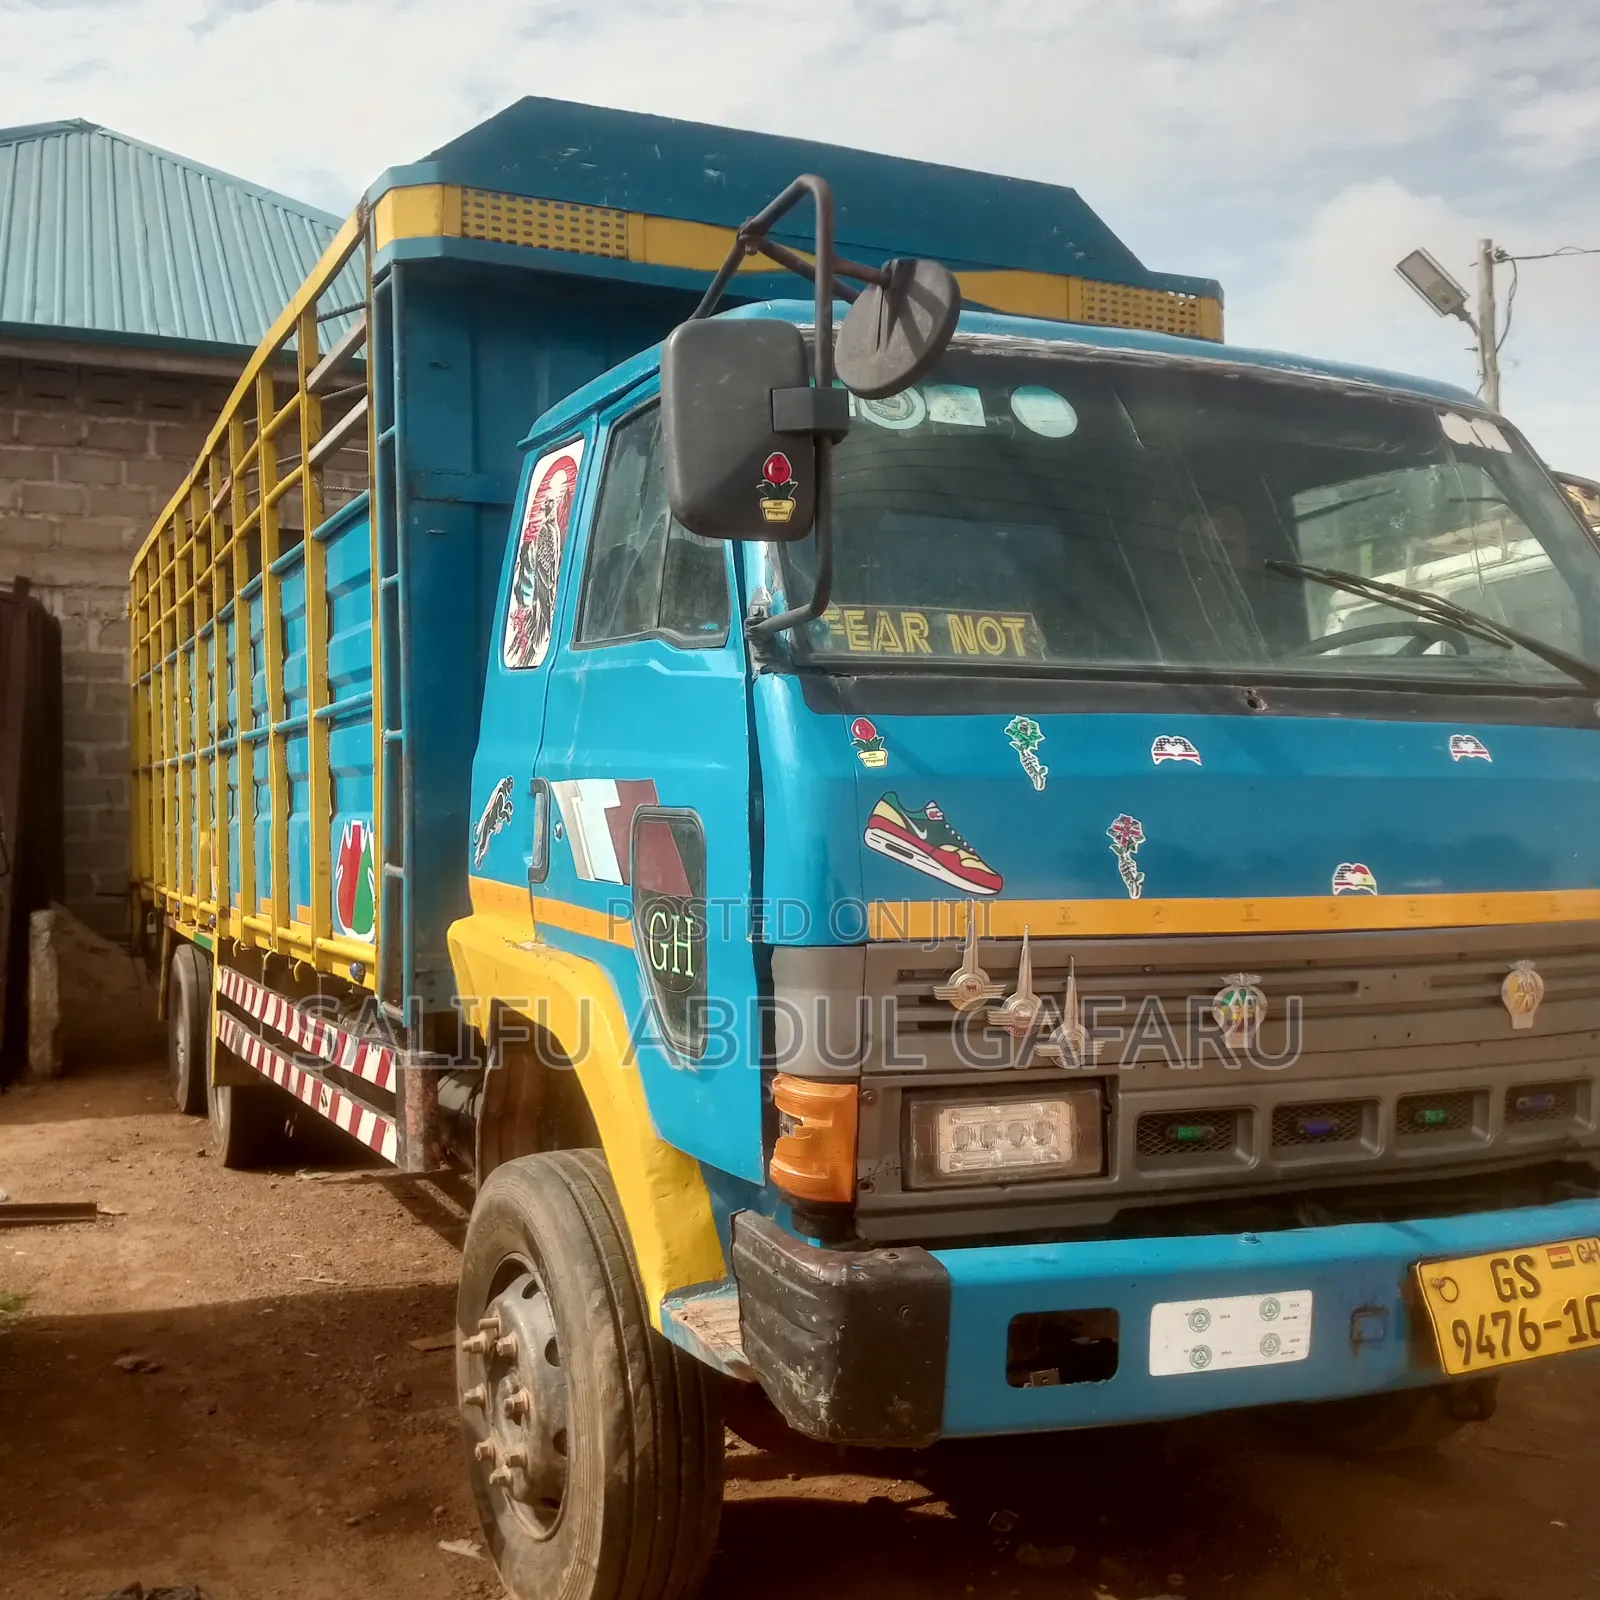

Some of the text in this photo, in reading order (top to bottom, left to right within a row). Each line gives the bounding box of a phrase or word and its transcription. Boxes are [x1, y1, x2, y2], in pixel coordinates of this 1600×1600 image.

[821, 609, 1026, 657] FEAR NOT
[648, 909, 695, 978] GH
[1489, 1254, 1541, 1303] GS
[1451, 1294, 1600, 1366] 9476-10
